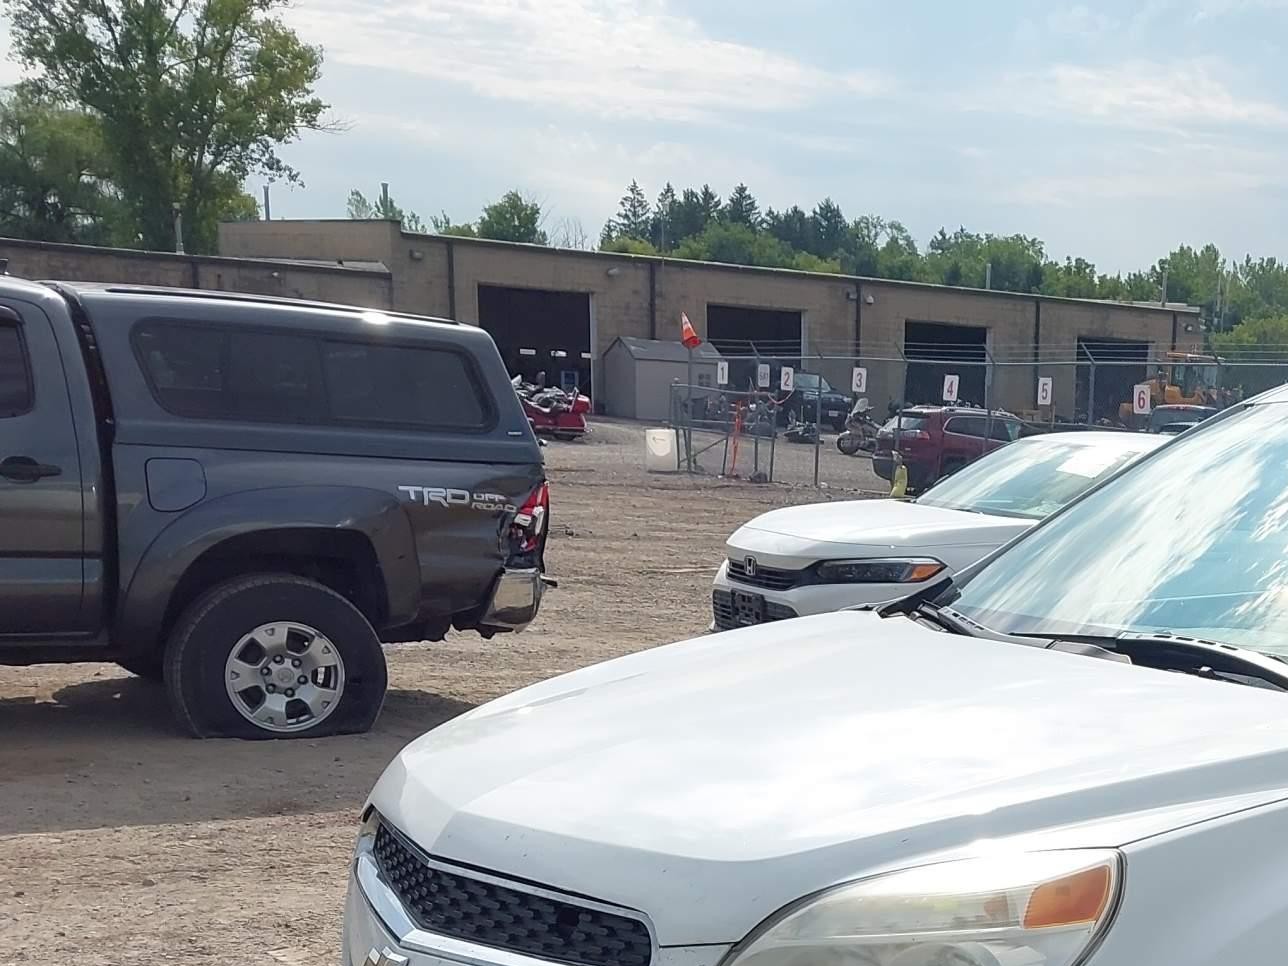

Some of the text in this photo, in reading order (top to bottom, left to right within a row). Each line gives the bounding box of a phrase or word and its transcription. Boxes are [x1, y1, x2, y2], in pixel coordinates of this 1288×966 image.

[784, 372, 791, 387] 2
[856, 373, 864, 388] 3
[946, 380, 955, 396] 4
[1041, 383, 1049, 400] 5
[1137, 390, 1146, 408] 6
[398, 485, 507, 508] TRD OFF
[471, 501, 517, 513] ROAD
